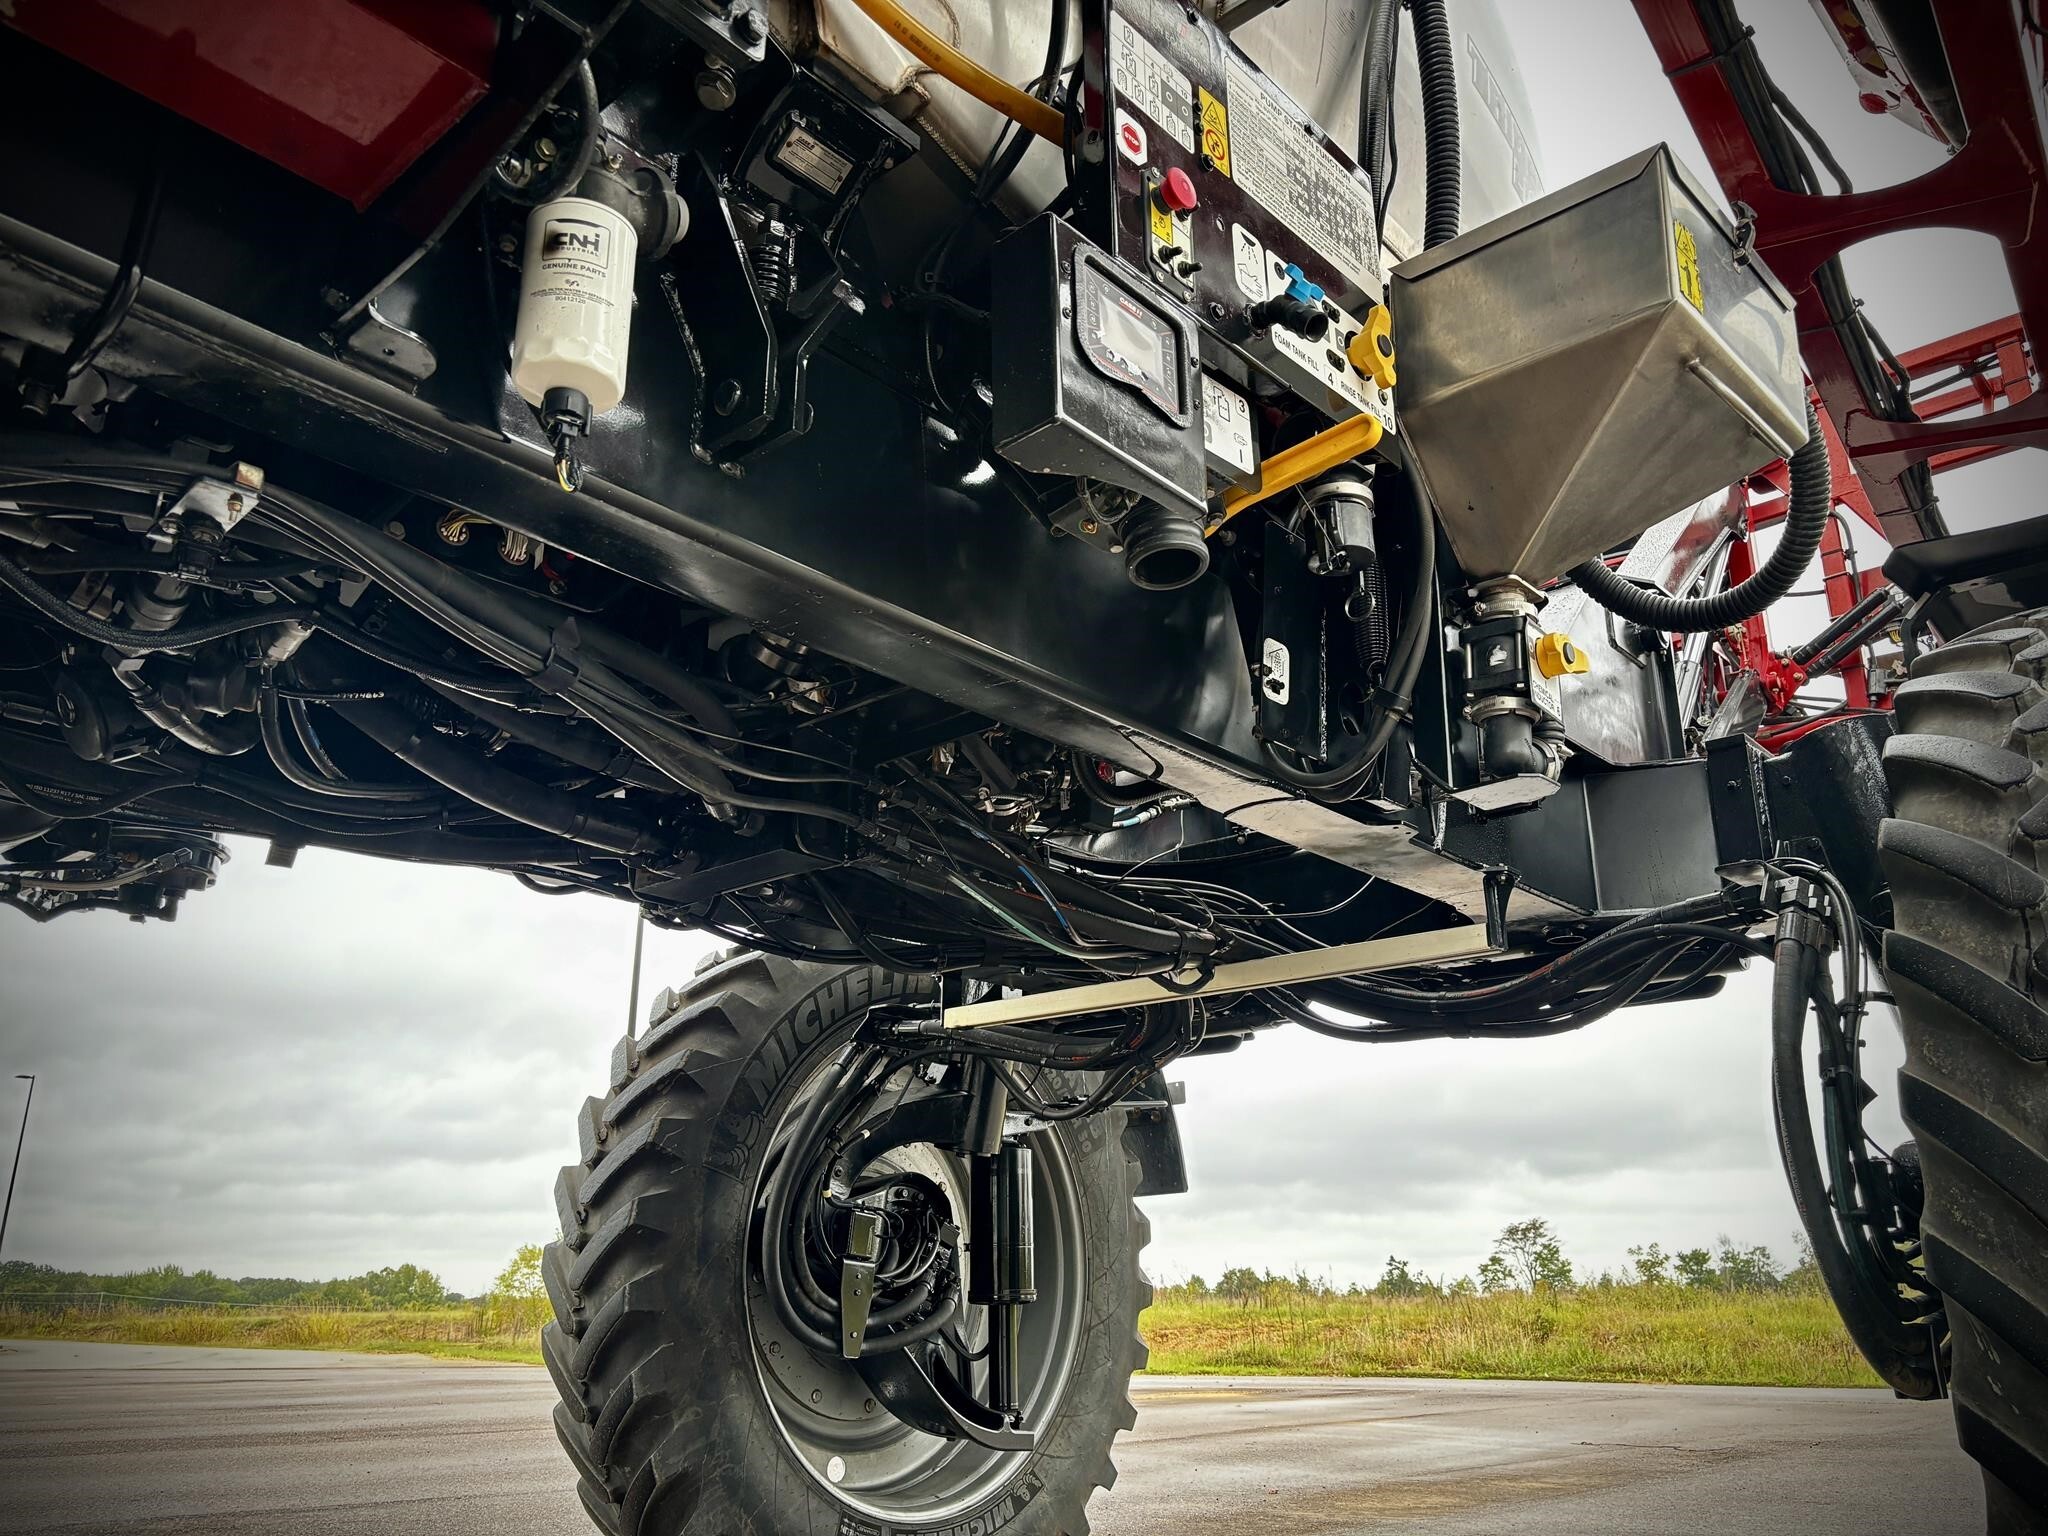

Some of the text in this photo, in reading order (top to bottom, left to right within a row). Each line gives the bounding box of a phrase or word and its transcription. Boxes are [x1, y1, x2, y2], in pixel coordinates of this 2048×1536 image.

[1124, 131, 1140, 146] STOP
[1260, 92, 1351, 184] PUMP STATION FUNCTION
[542, 261, 578, 270] GENUINE
[580, 263, 607, 278] PARTS
[1119, 297, 1136, 312] CASE
[1274, 331, 1320, 372] FOAM TANK FILL
[1327, 372, 1334, 387] 4
[1238, 399, 1246, 413] 3
[1340, 381, 1382, 419] RINSE TANK FILL
[1383, 414, 1393, 431] 10
